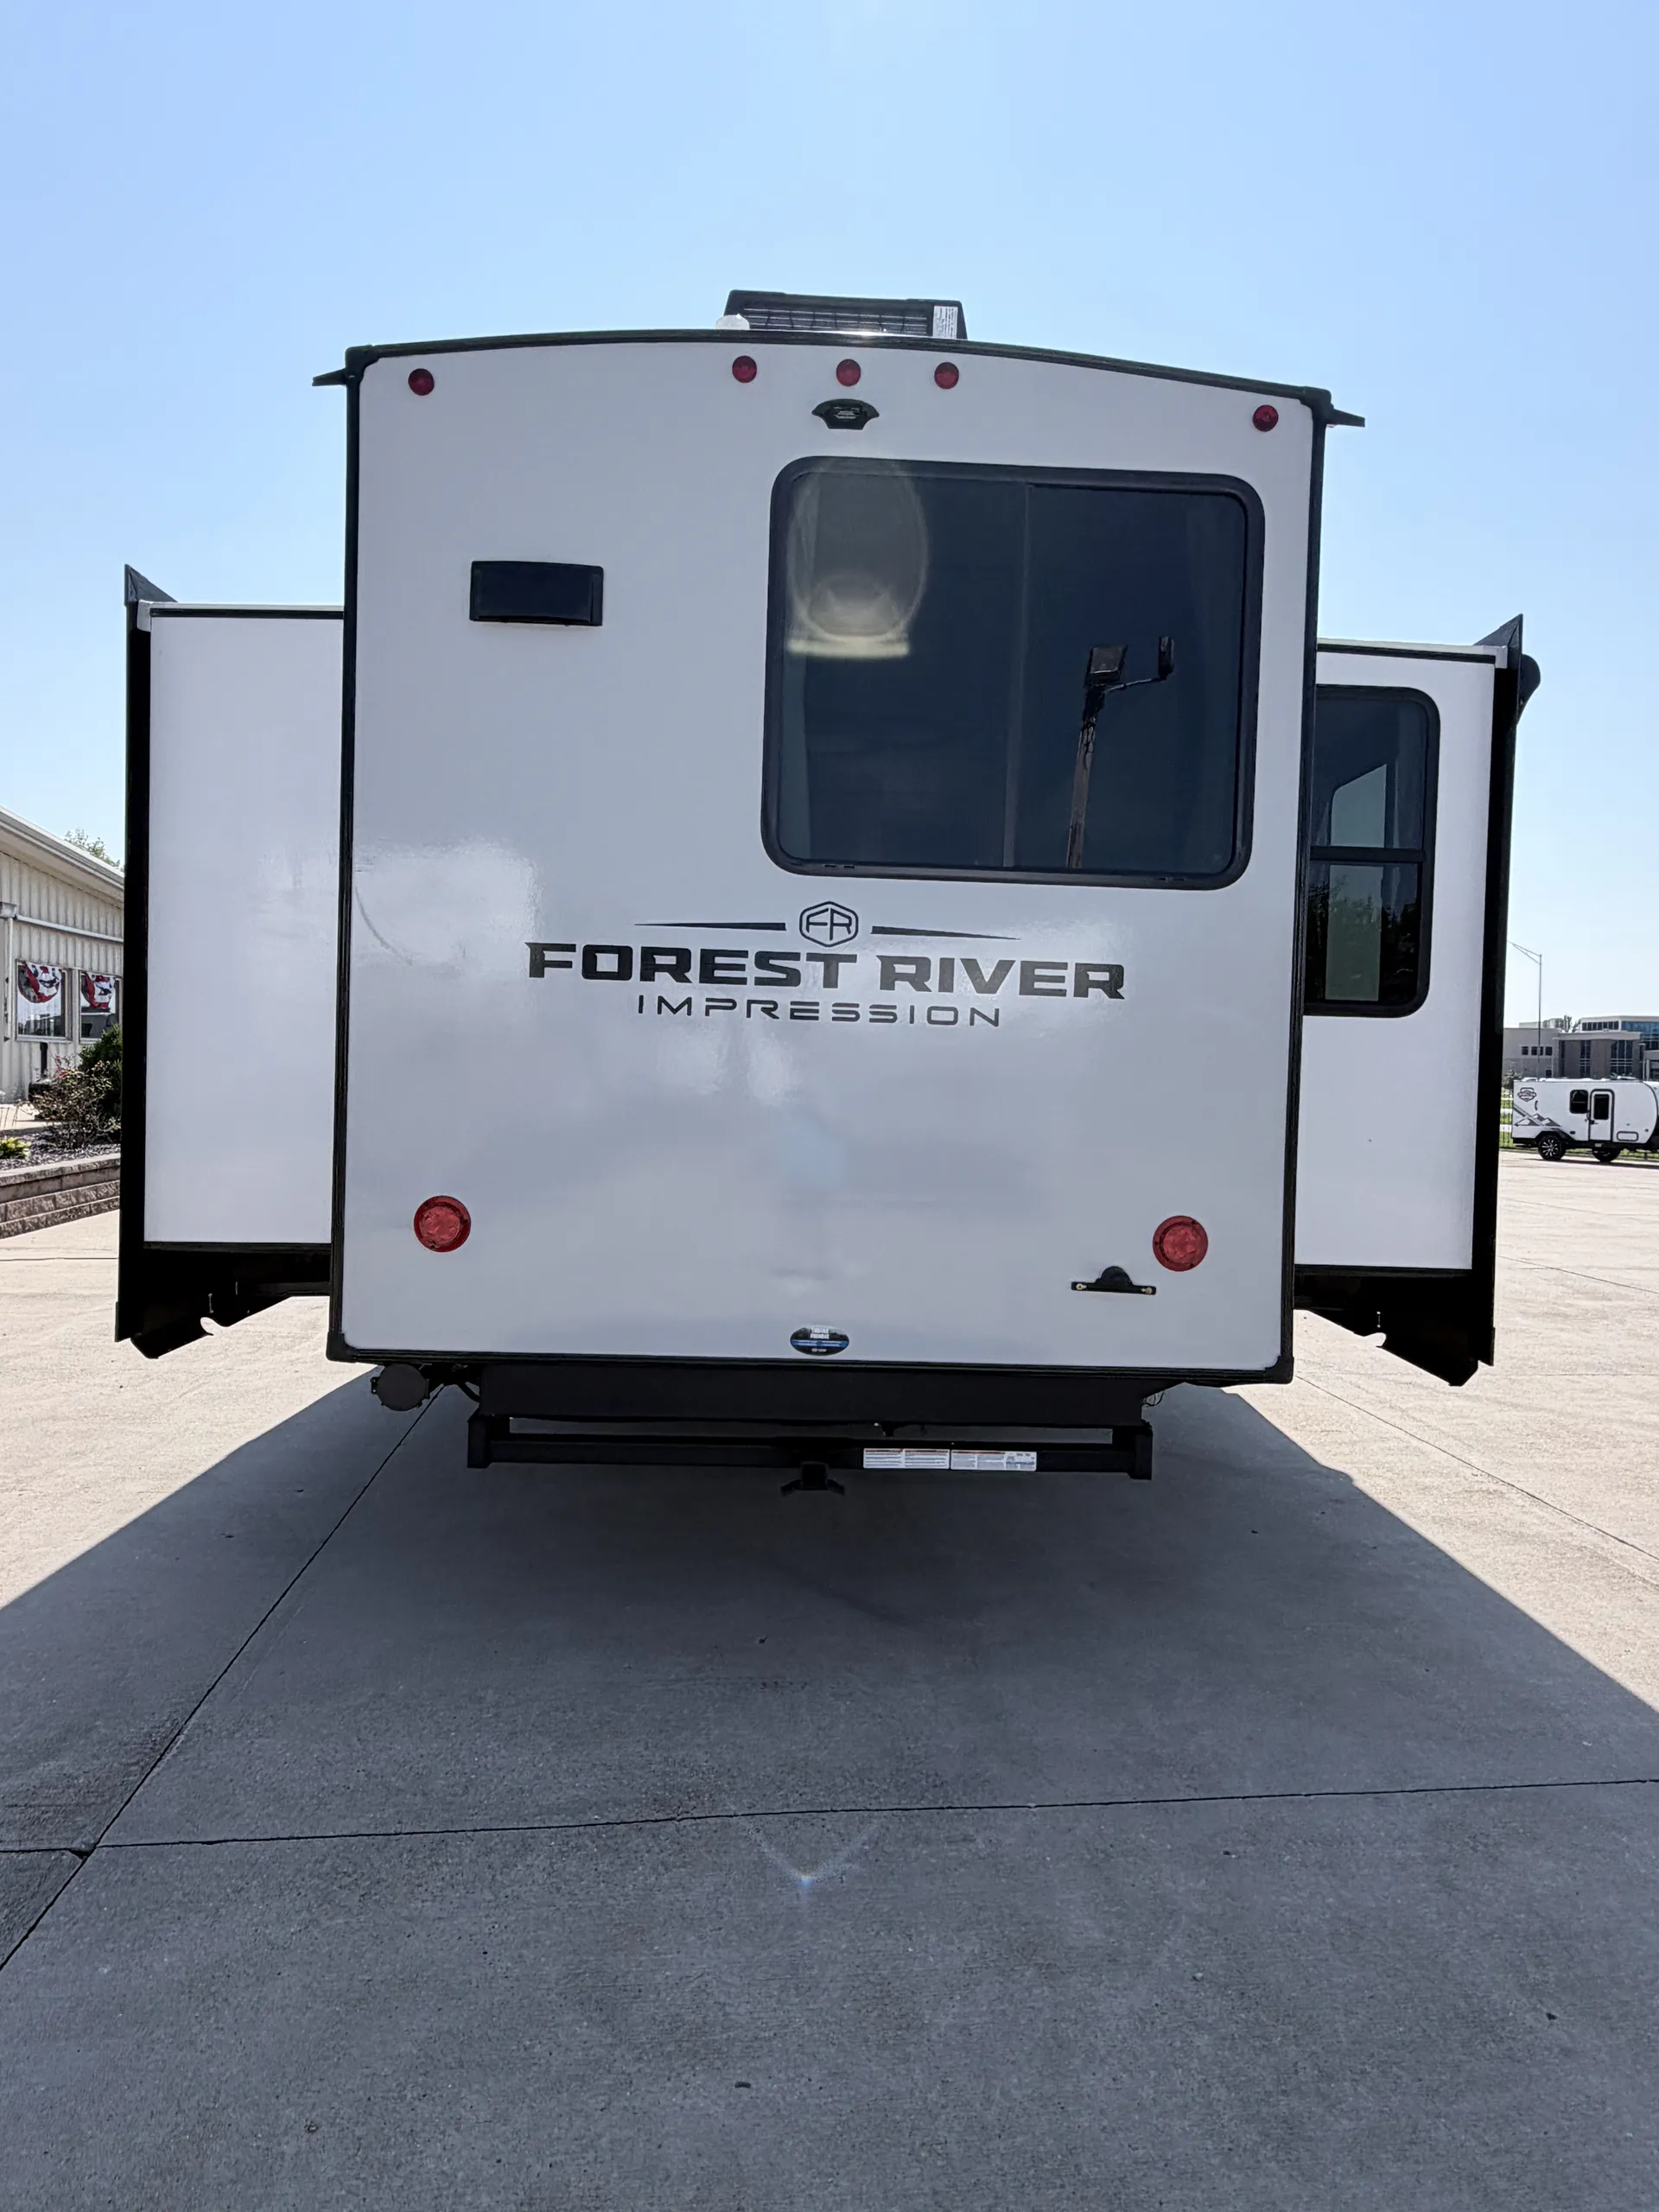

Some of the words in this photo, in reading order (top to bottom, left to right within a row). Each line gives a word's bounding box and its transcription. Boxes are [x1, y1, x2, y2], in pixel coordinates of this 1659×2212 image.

[524, 941, 858, 989] FOREST
[875, 955, 1126, 1001] RIVER
[638, 995, 1001, 1027] IMPRESSION
